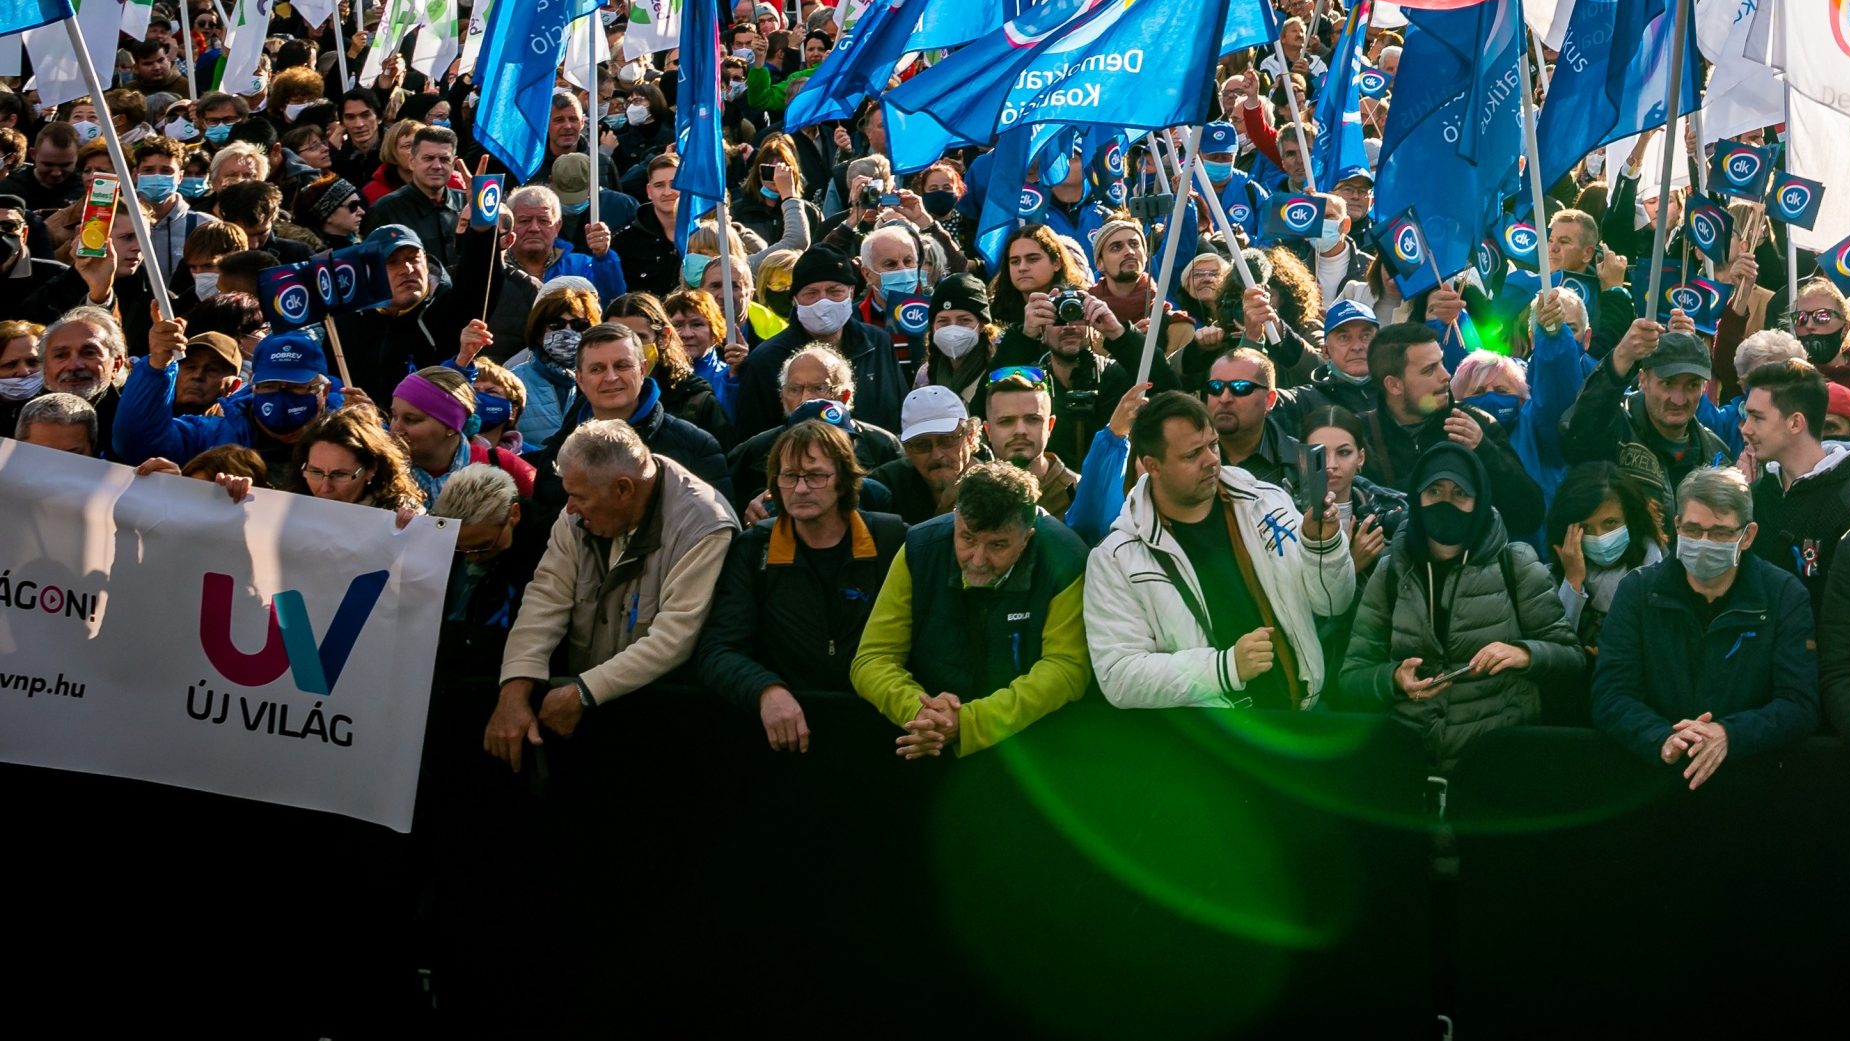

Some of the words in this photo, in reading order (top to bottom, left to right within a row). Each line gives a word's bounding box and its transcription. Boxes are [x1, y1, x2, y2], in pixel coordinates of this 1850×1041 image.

[1364, 75, 1376, 88] dk
[1734, 160, 1751, 174] dk
[1786, 192, 1802, 206] dk
[1292, 207, 1309, 221] dk
[1699, 221, 1709, 237] dk
[1403, 235, 1417, 252] dk
[1515, 233, 1530, 247] dk
[286, 295, 303, 310] dk
[906, 309, 923, 322] dk
[186, 679, 230, 724] ÚJ
[239, 697, 354, 747] VILÁG
